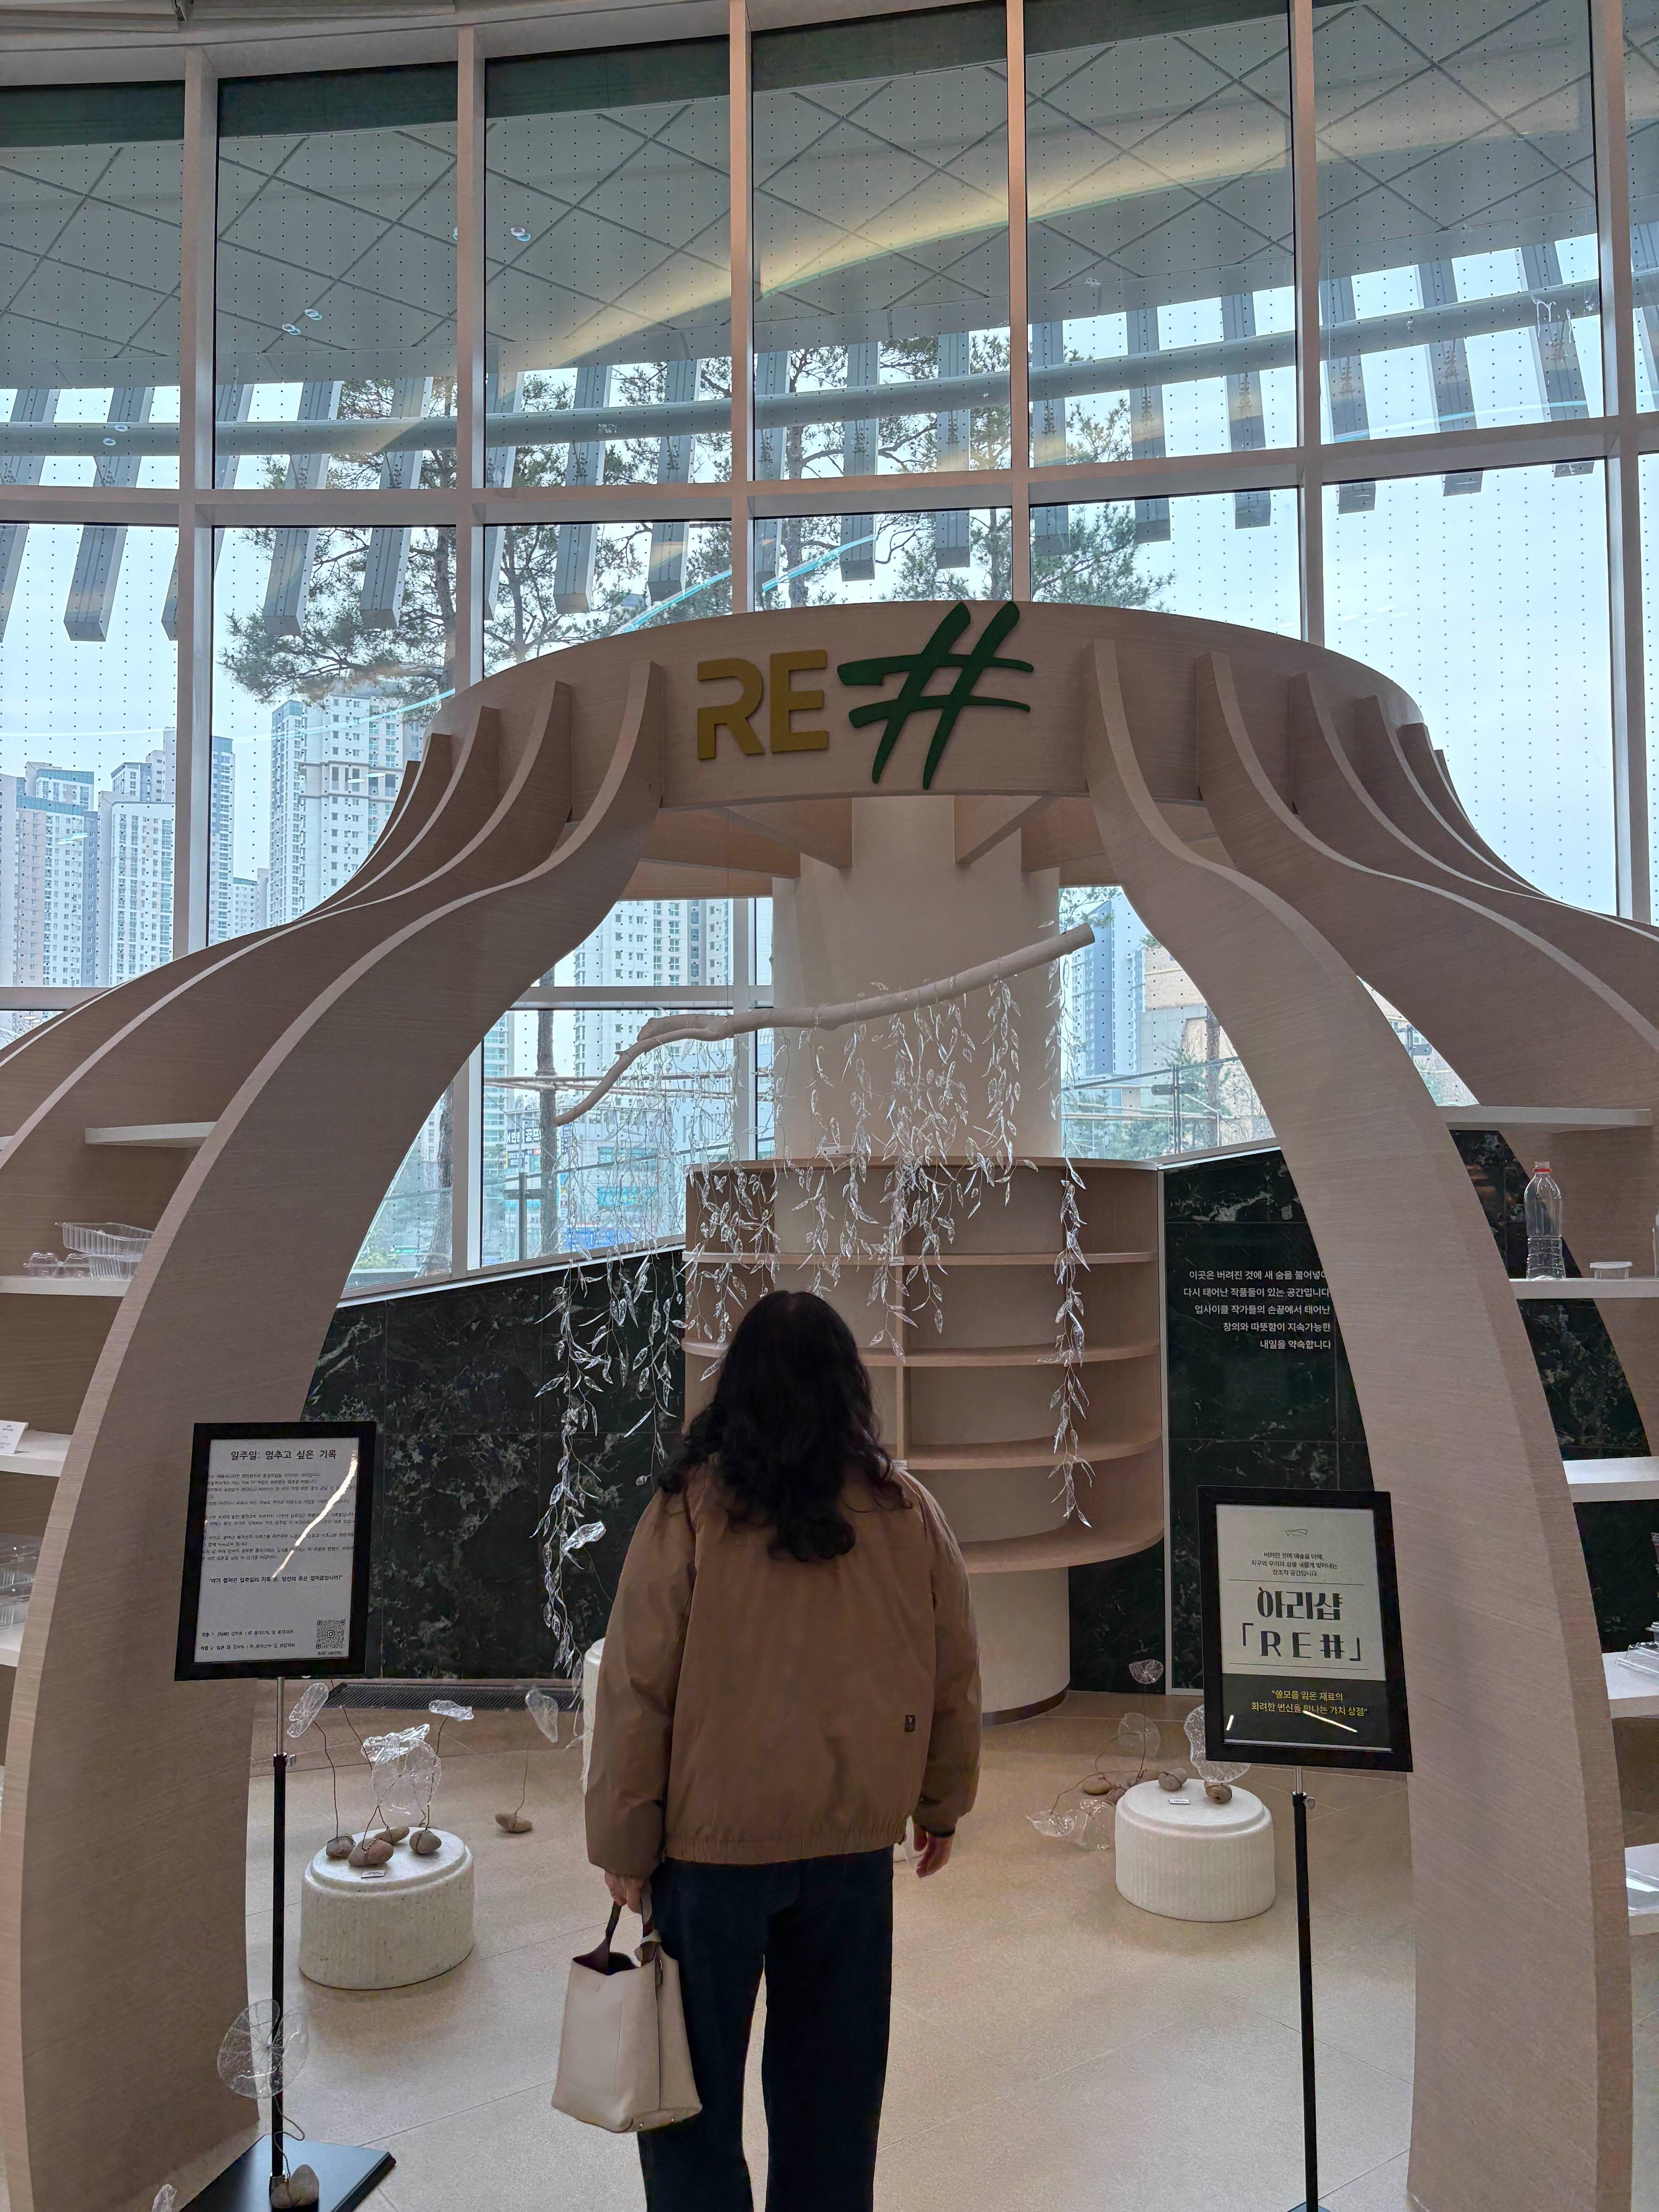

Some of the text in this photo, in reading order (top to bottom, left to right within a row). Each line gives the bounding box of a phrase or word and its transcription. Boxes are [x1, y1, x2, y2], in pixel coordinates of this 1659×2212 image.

[1189, 1270, 1214, 1280] 이곳은
[1217, 1270, 1242, 1280] 버려진
[1245, 1270, 1262, 1280] 것에
[1264, 1270, 1273, 1280] 새
[1275, 1270, 1293, 1280] 숨을
[1183, 1288, 1200, 1297] 다시
[1203, 1288, 1228, 1297] 태어난
[1231, 1288, 1264, 1297] 작품들이
[1267, 1288, 1285, 1297] 있는
[1195, 1305, 1331, 1314] 업사이클 작가들의 손끝에서 태어난
[1223, 1322, 1331, 1332] 창의와 따뜻함이 지속가능한
[1260, 1340, 1331, 1349] 내일을 약속합니다
[231, 1449, 337, 1461] 일주일: 멈추고 싶은 기록
[1319, 1692, 1343, 1701] 재료의
[1251, 1701, 1275, 1712] 화려한
[1330, 1706, 1345, 1715] 가치
